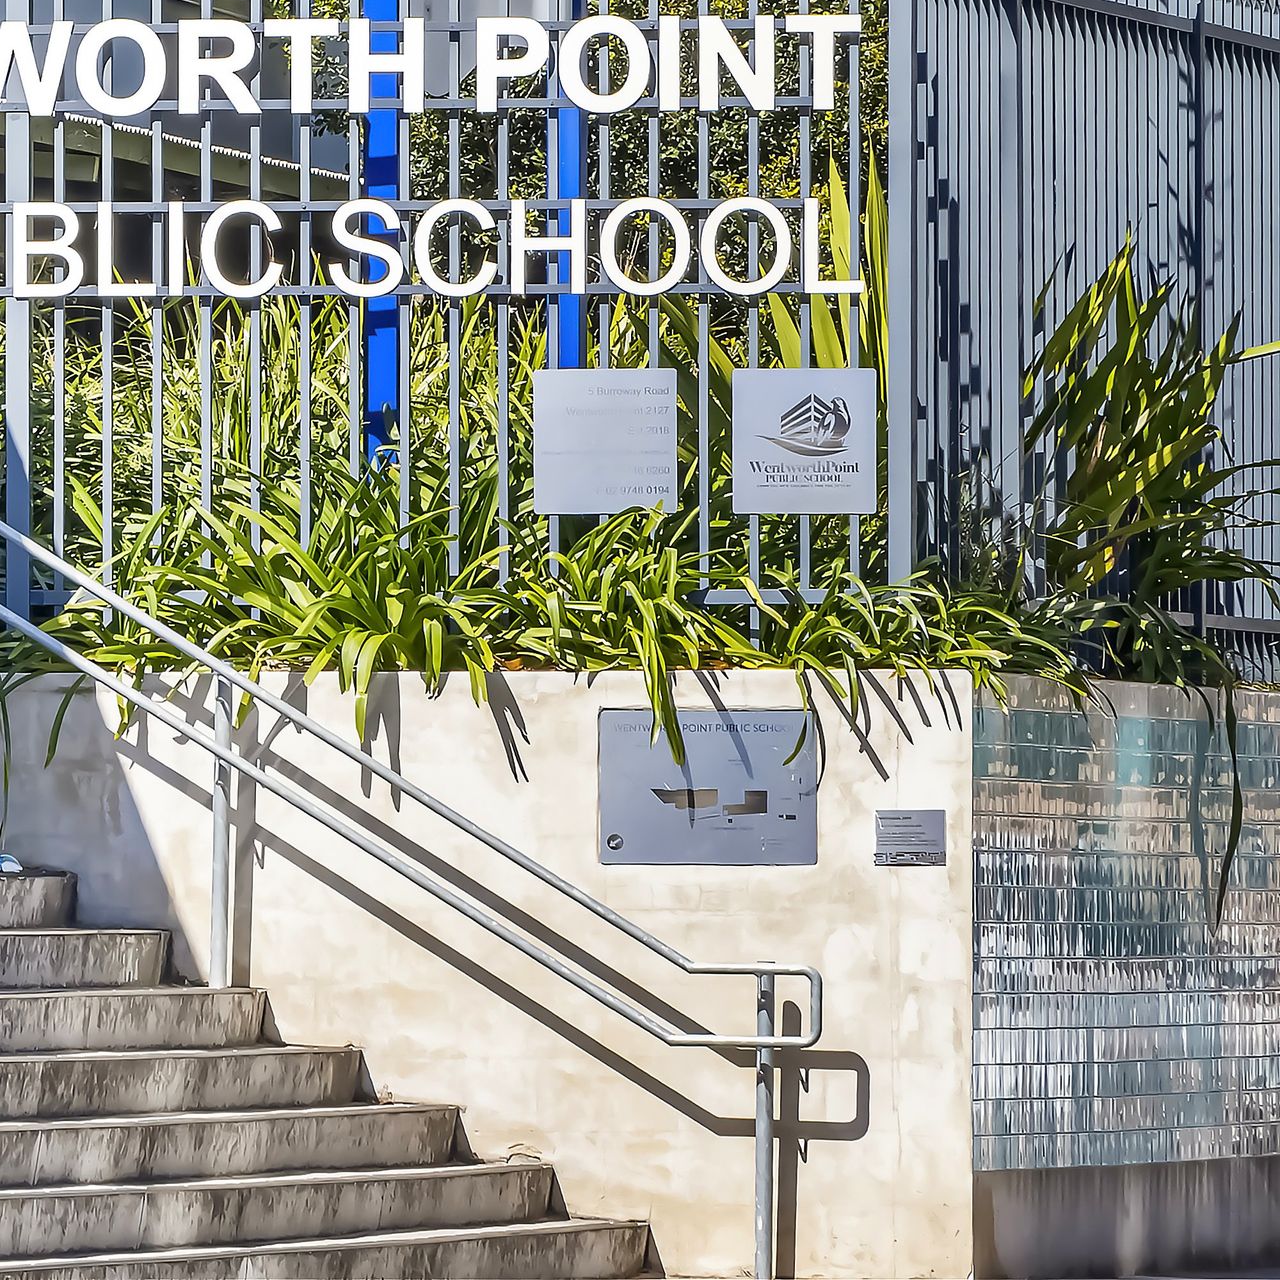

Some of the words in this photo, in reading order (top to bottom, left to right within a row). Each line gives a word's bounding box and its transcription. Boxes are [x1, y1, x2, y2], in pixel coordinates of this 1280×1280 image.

[475, 13, 864, 114] POINT
[330, 197, 867, 299] SCHOOL
[588, 387, 594, 395] 5
[644, 387, 670, 395] Road
[645, 406, 670, 414] 2127
[765, 474, 801, 482] PUBLIC
[803, 474, 843, 482] SCHOOL
[646, 486, 670, 495] 0194
[614, 723, 672, 732] WENTW
[682, 723, 712, 732] POINT
[715, 723, 750, 732] PUBLIC
[753, 723, 792, 732] SCHOO
